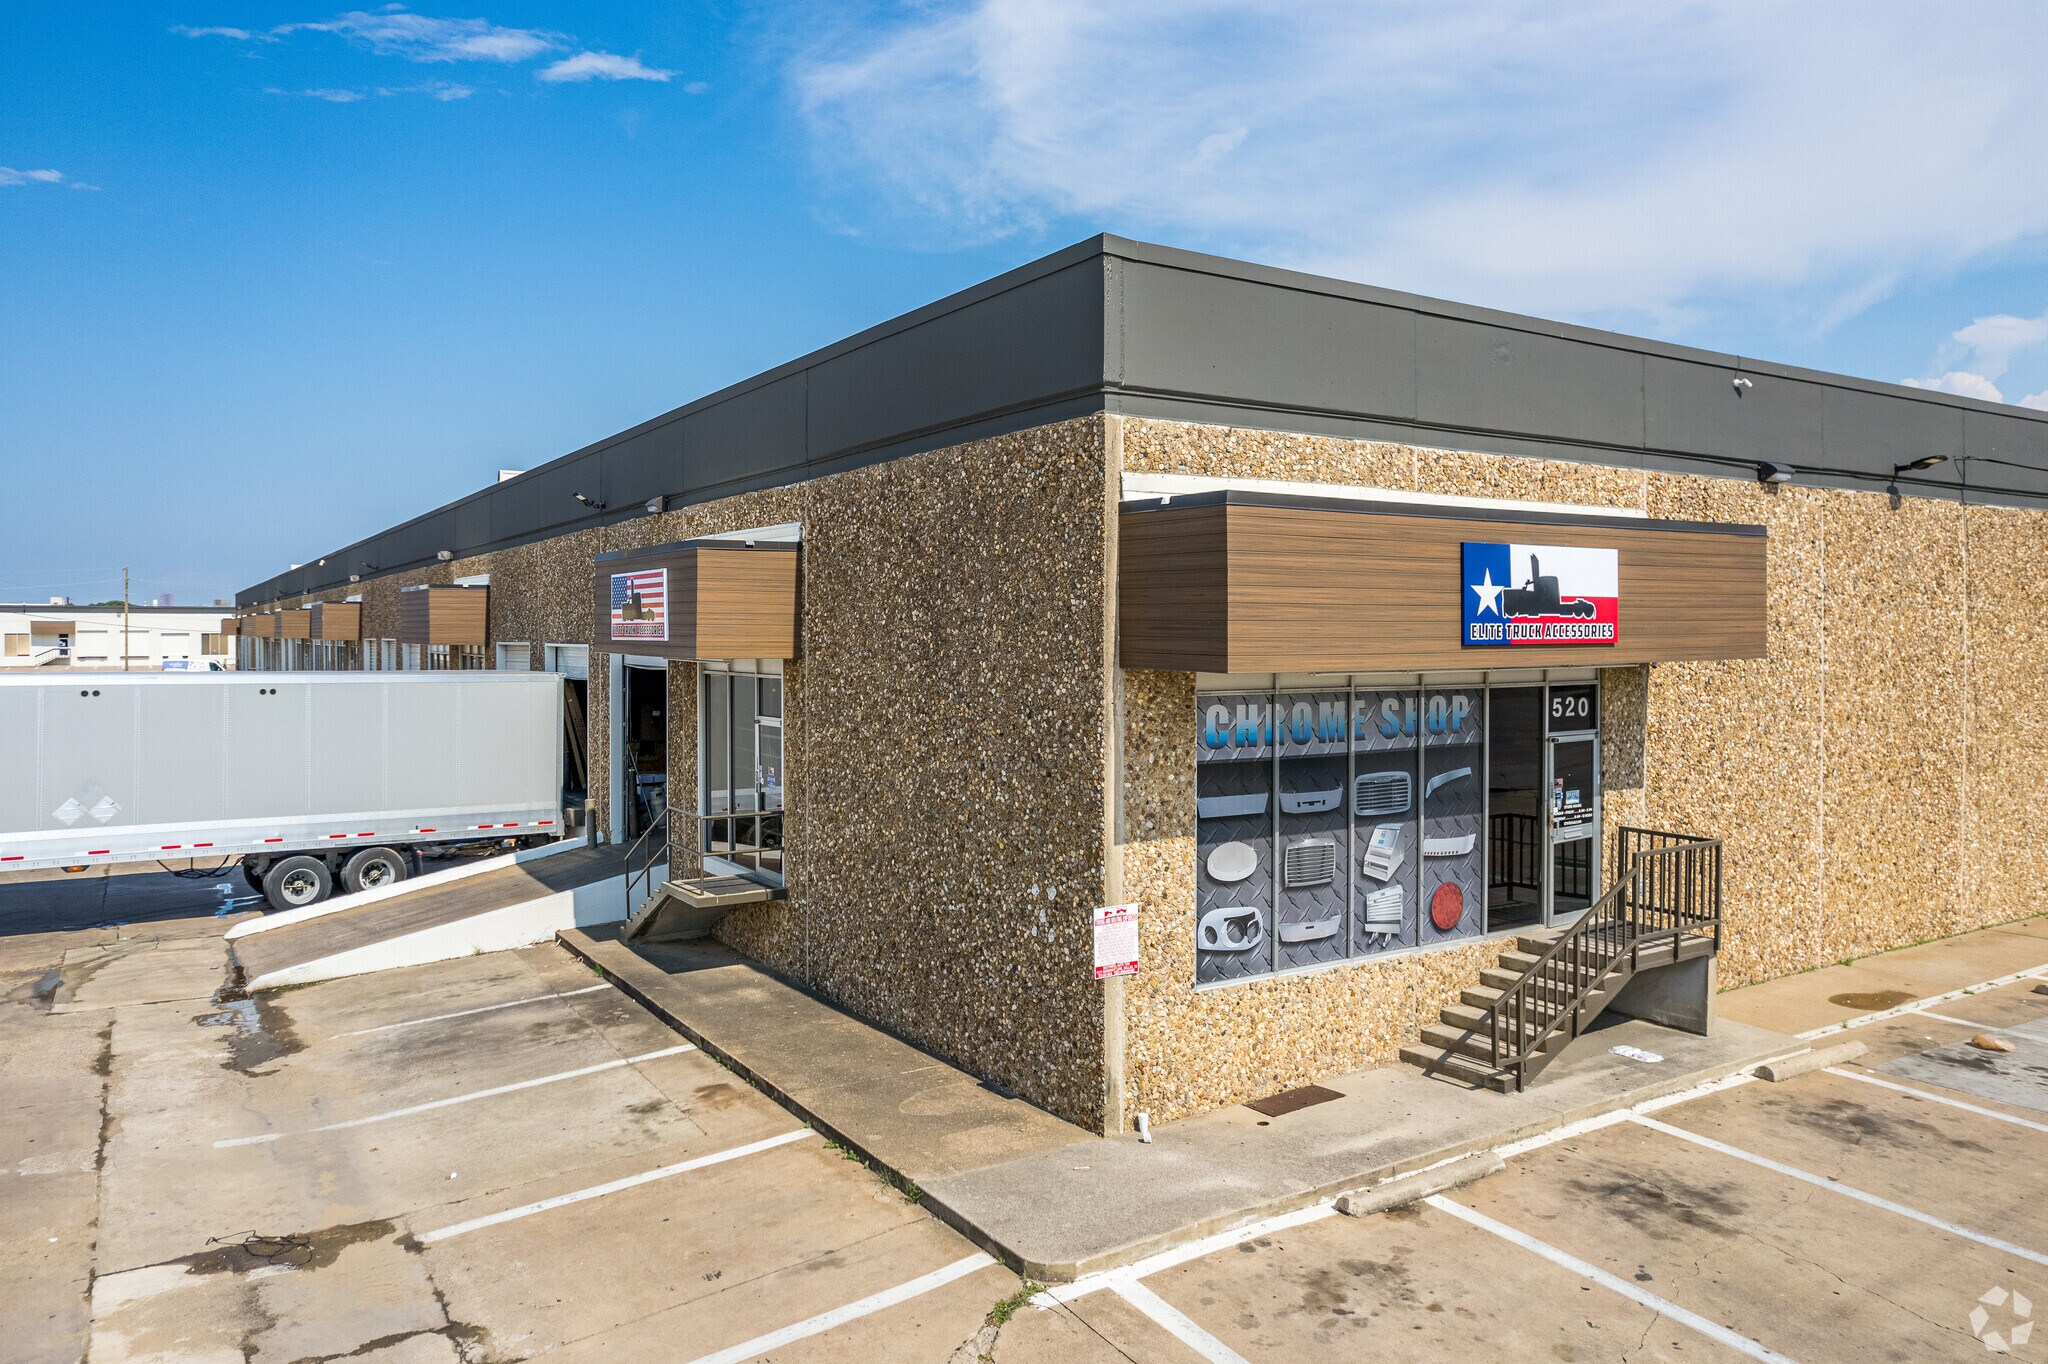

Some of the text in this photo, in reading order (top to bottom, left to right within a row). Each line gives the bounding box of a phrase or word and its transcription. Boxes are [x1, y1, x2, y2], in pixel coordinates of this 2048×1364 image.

[1470, 622, 1614, 640] ELITE TRUCK ACCESSORIES
[1552, 696, 1589, 718] 520
[1205, 695, 1469, 750] CHROME SHOP
